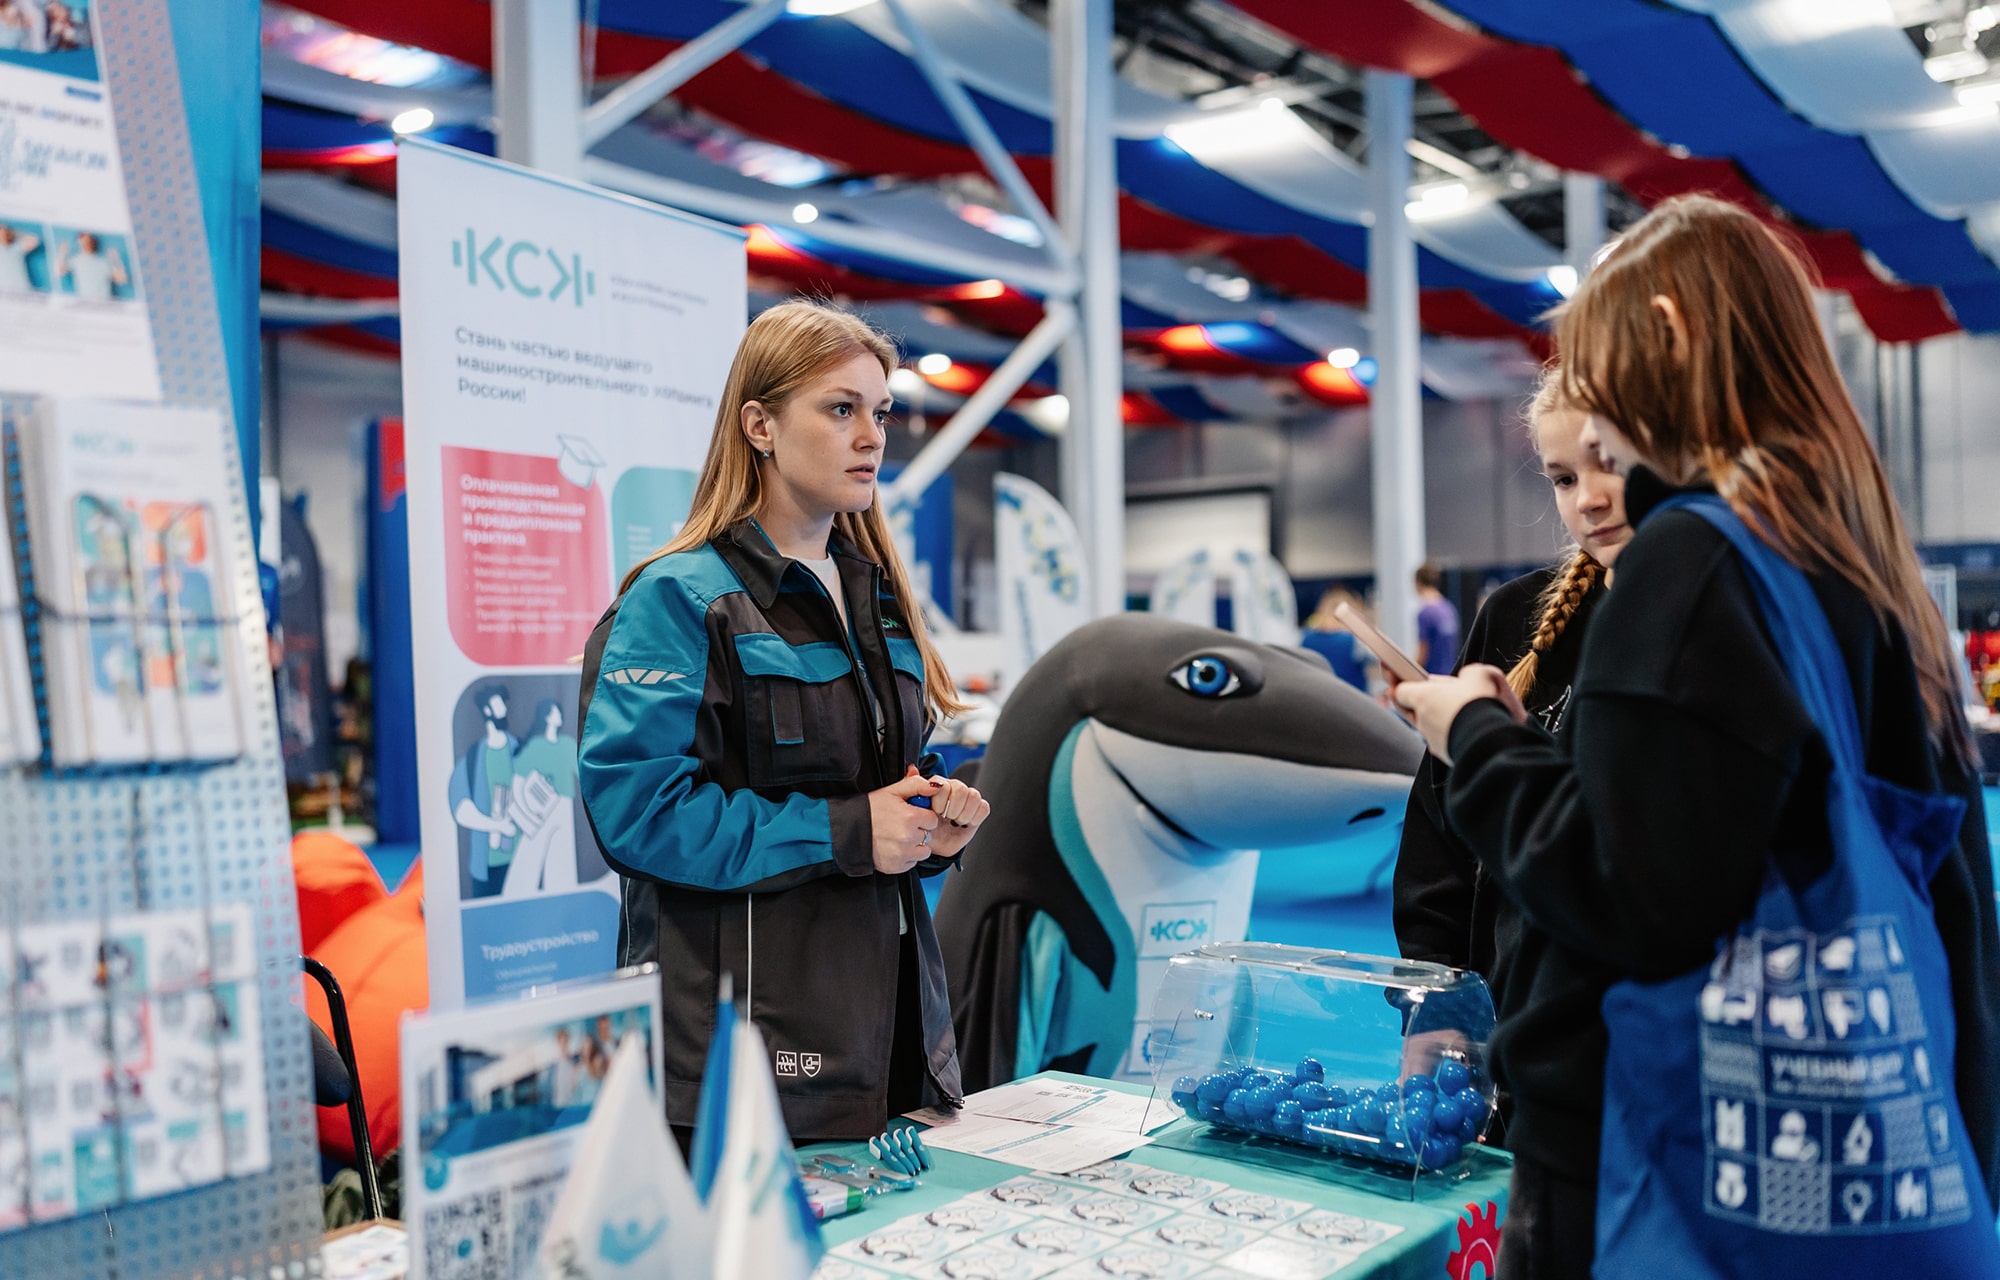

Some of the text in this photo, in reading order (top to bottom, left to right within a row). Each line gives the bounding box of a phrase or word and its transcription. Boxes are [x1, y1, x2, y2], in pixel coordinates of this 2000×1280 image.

[455, 325, 653, 376] Стань частью ведущего
[458, 378, 526, 403] России!
[460, 474, 559, 498] Оплачиваемая
[462, 494, 585, 517] производственная
[463, 515, 473, 526] и
[464, 530, 526, 546] практика
[481, 929, 599, 961] Трудоустройство
